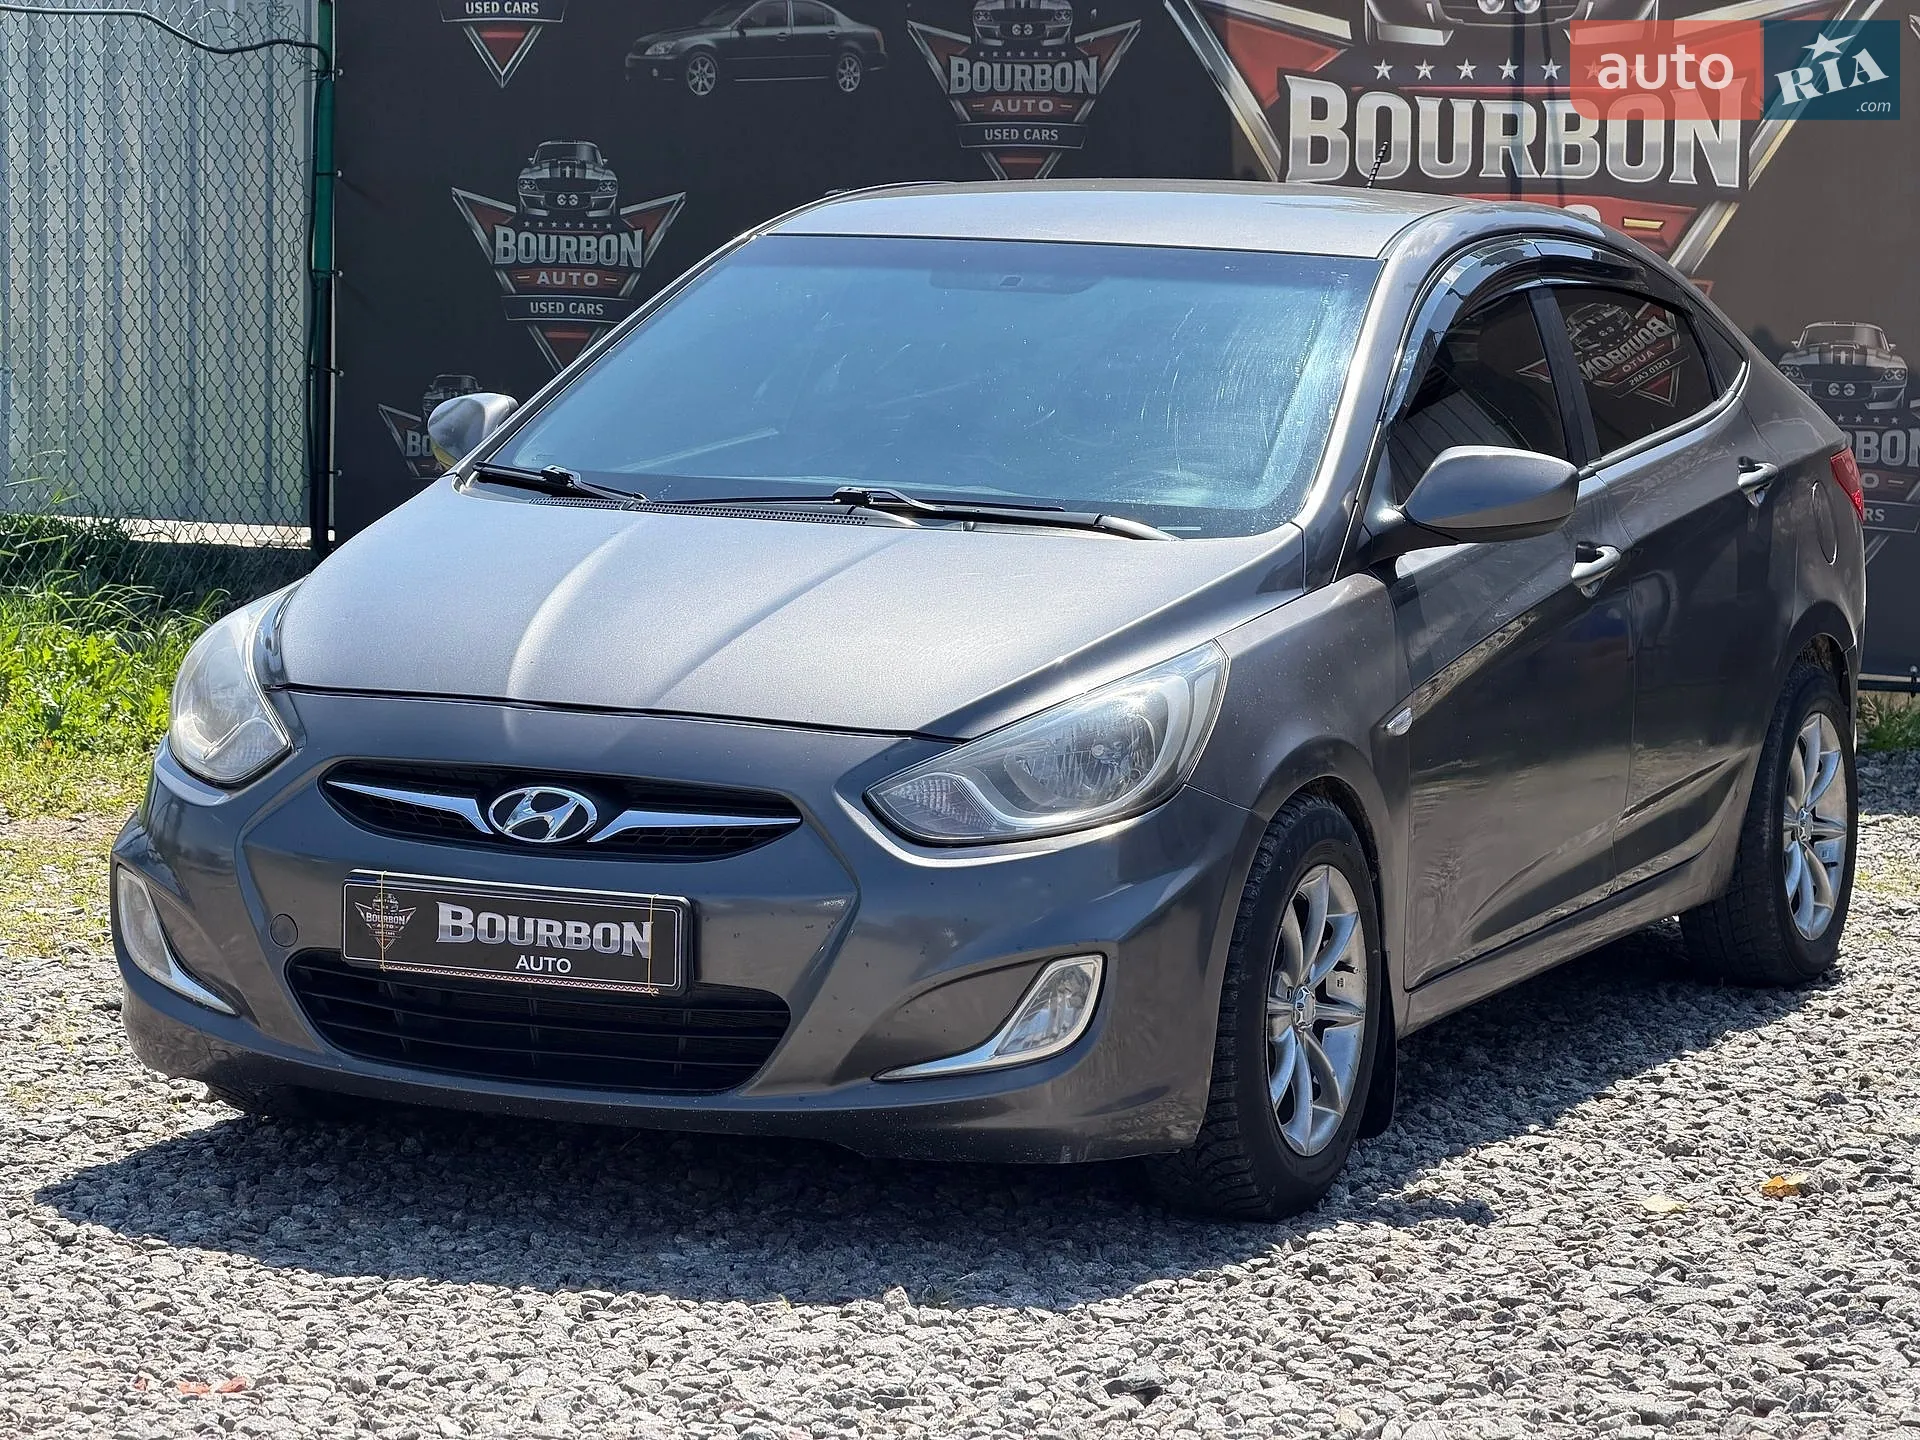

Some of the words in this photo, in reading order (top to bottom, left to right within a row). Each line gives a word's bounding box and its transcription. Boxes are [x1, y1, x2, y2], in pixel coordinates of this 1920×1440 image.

[465, 2, 500, 14] USED
[504, 2, 539, 14] CARS
[950, 55, 1099, 95] BOURBON
[991, 99, 1054, 113] AUTO
[984, 128, 1019, 141] USED
[1023, 128, 1058, 141] CARS
[1284, 75, 1748, 188] BOURBON
[494, 225, 644, 268] BOURBON
[536, 271, 599, 287] AUTO
[530, 301, 565, 314] USED
[569, 302, 604, 315] CARS
[436, 901, 654, 959] BOURBON
[515, 955, 572, 973] AUTO
